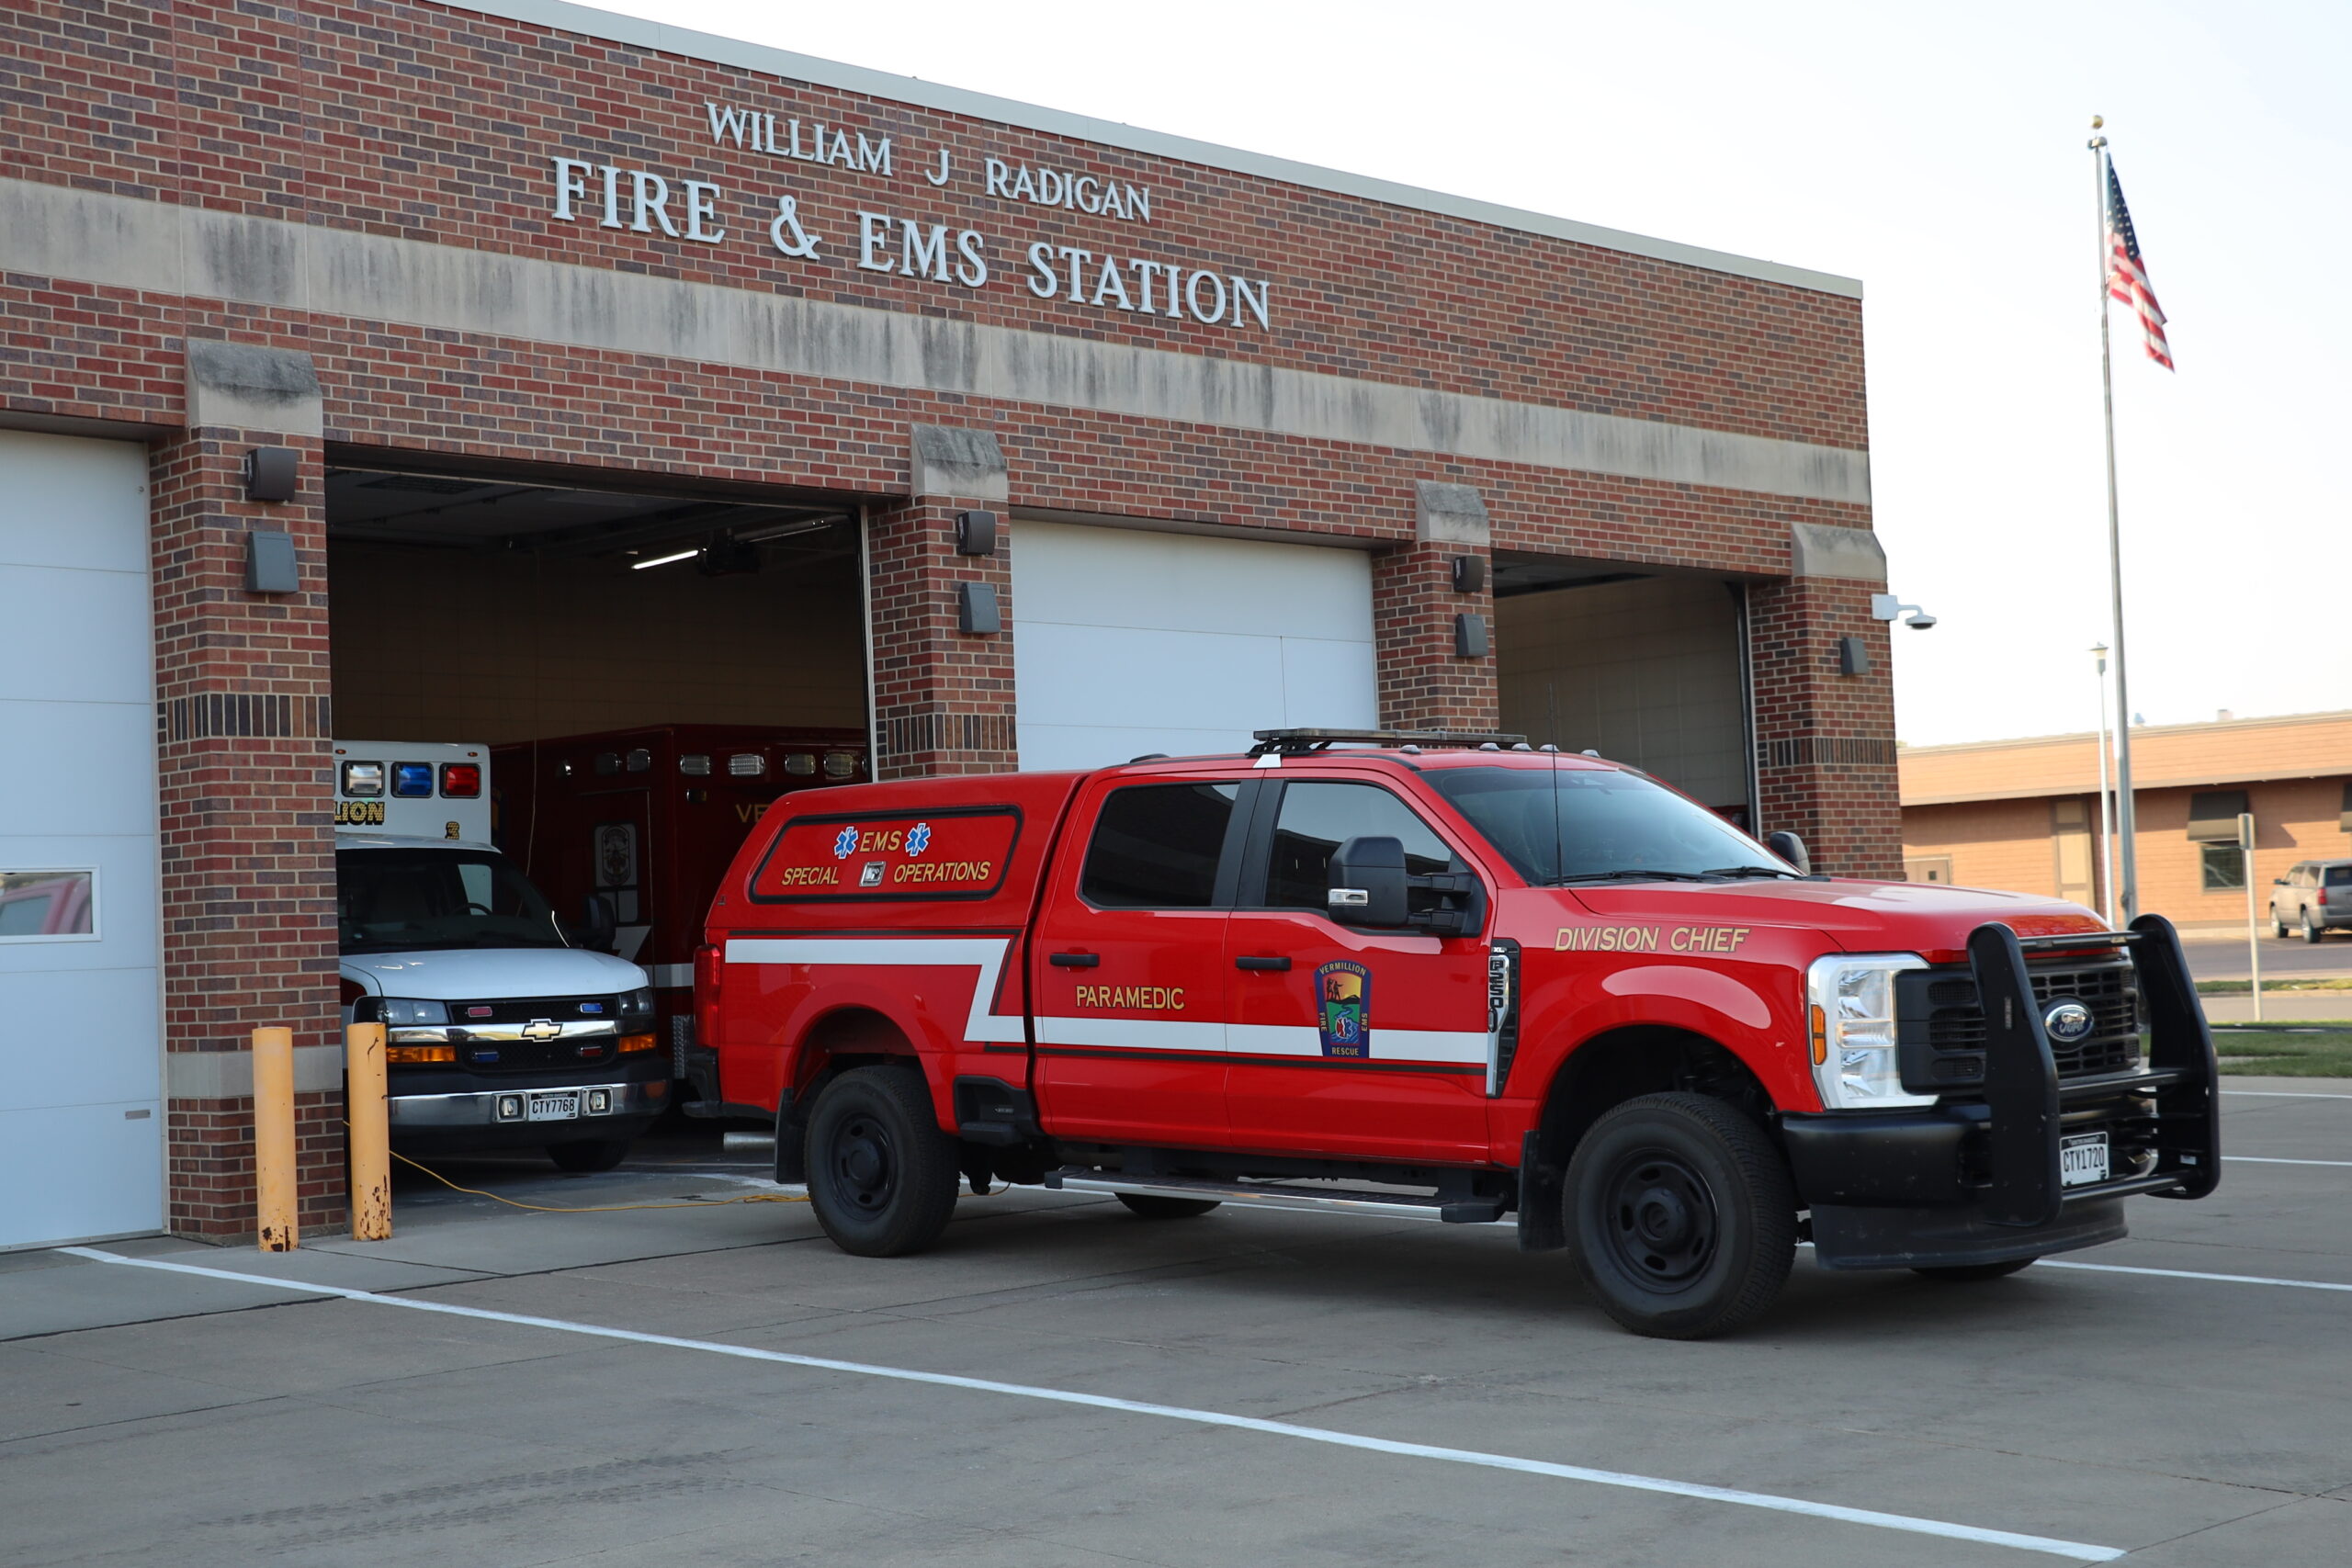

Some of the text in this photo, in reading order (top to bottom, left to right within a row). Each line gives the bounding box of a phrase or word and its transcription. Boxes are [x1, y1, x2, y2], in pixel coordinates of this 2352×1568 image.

[703, 101, 1150, 223] WILLIAM J RADIGAN
[551, 155, 1271, 333] FIRE & EMS STATION
[859, 830, 902, 852] EMS
[781, 862, 991, 886] SPECIAL OPERATIONS
[1555, 927, 1749, 953] DIVISION CHIEF
[1318, 962, 1367, 976] VERMILLION
[1076, 985, 1185, 1010] PARAMEDIC
[1319, 1012, 1328, 1032] FIRE
[1331, 1047, 1360, 1055] RESCUE
[532, 1099, 575, 1114] CTY7768
[2064, 1146, 2105, 1172] CTY1720
